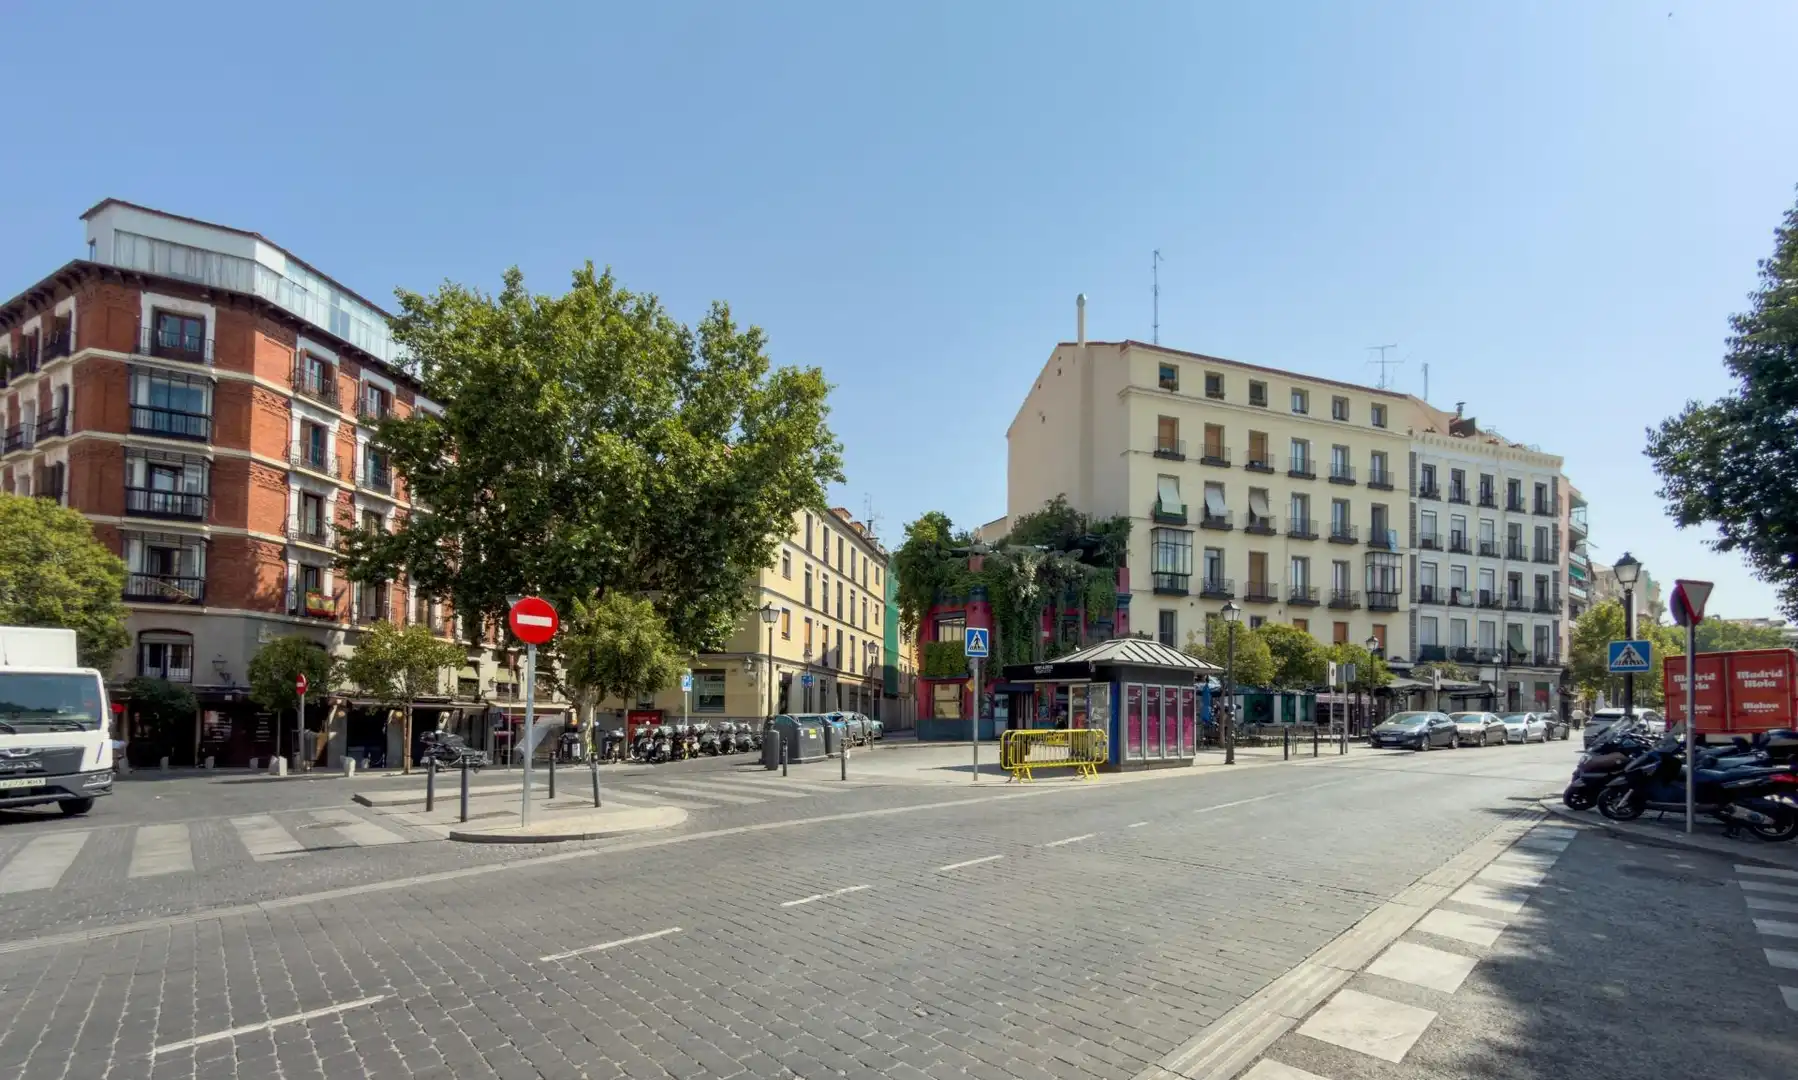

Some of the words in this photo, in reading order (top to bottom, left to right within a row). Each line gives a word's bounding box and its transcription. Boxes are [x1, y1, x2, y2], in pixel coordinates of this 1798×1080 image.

[1673, 672, 1716, 682] Mdrid
[1736, 669, 1783, 680] Madrid
[1744, 679, 1776, 688] Mola
